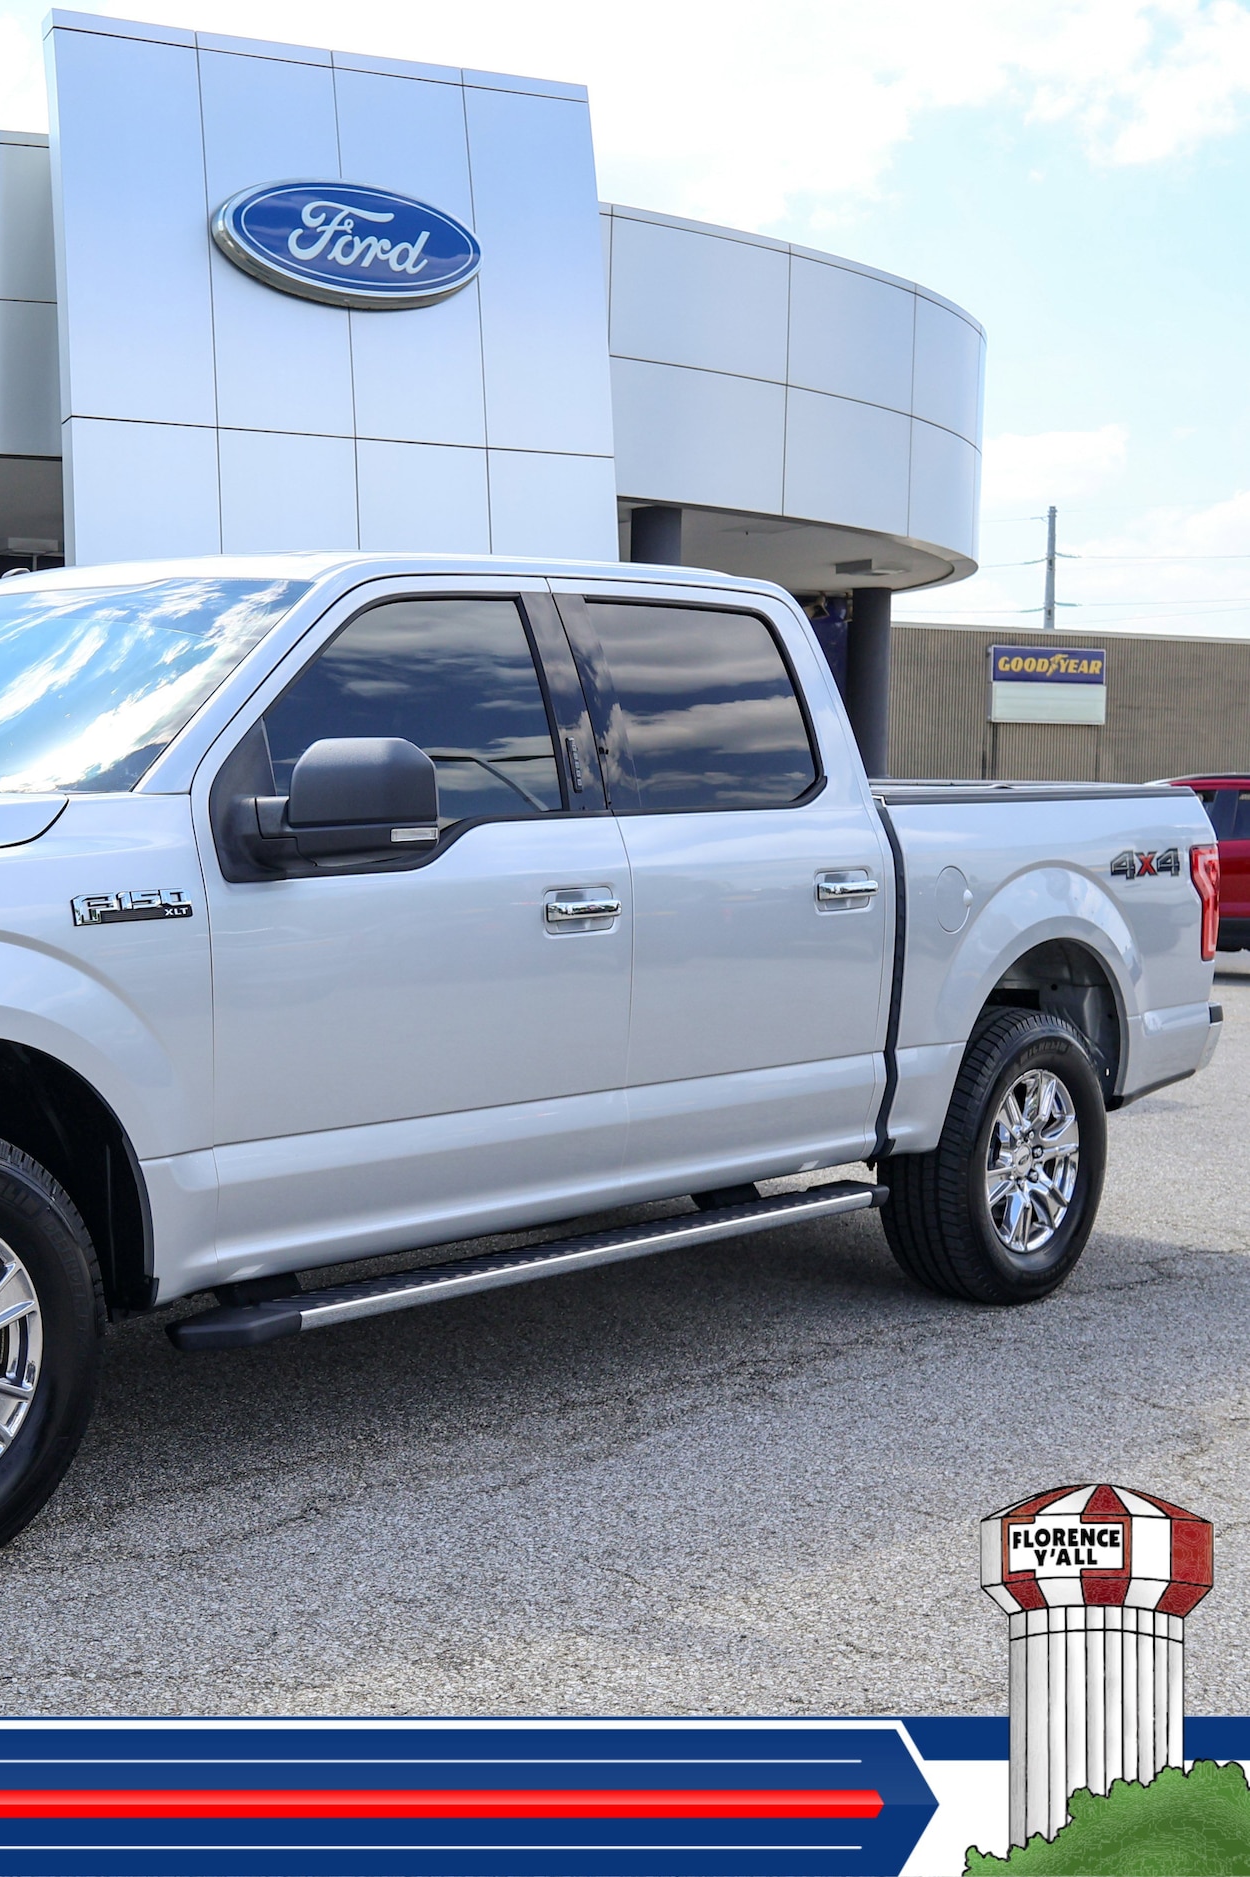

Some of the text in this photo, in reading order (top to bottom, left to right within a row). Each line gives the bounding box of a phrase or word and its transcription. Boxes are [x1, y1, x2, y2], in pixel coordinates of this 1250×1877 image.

[287, 200, 431, 275] Ford
[997, 654, 1103, 676] GOODYEAR
[164, 906, 189, 916] XLT
